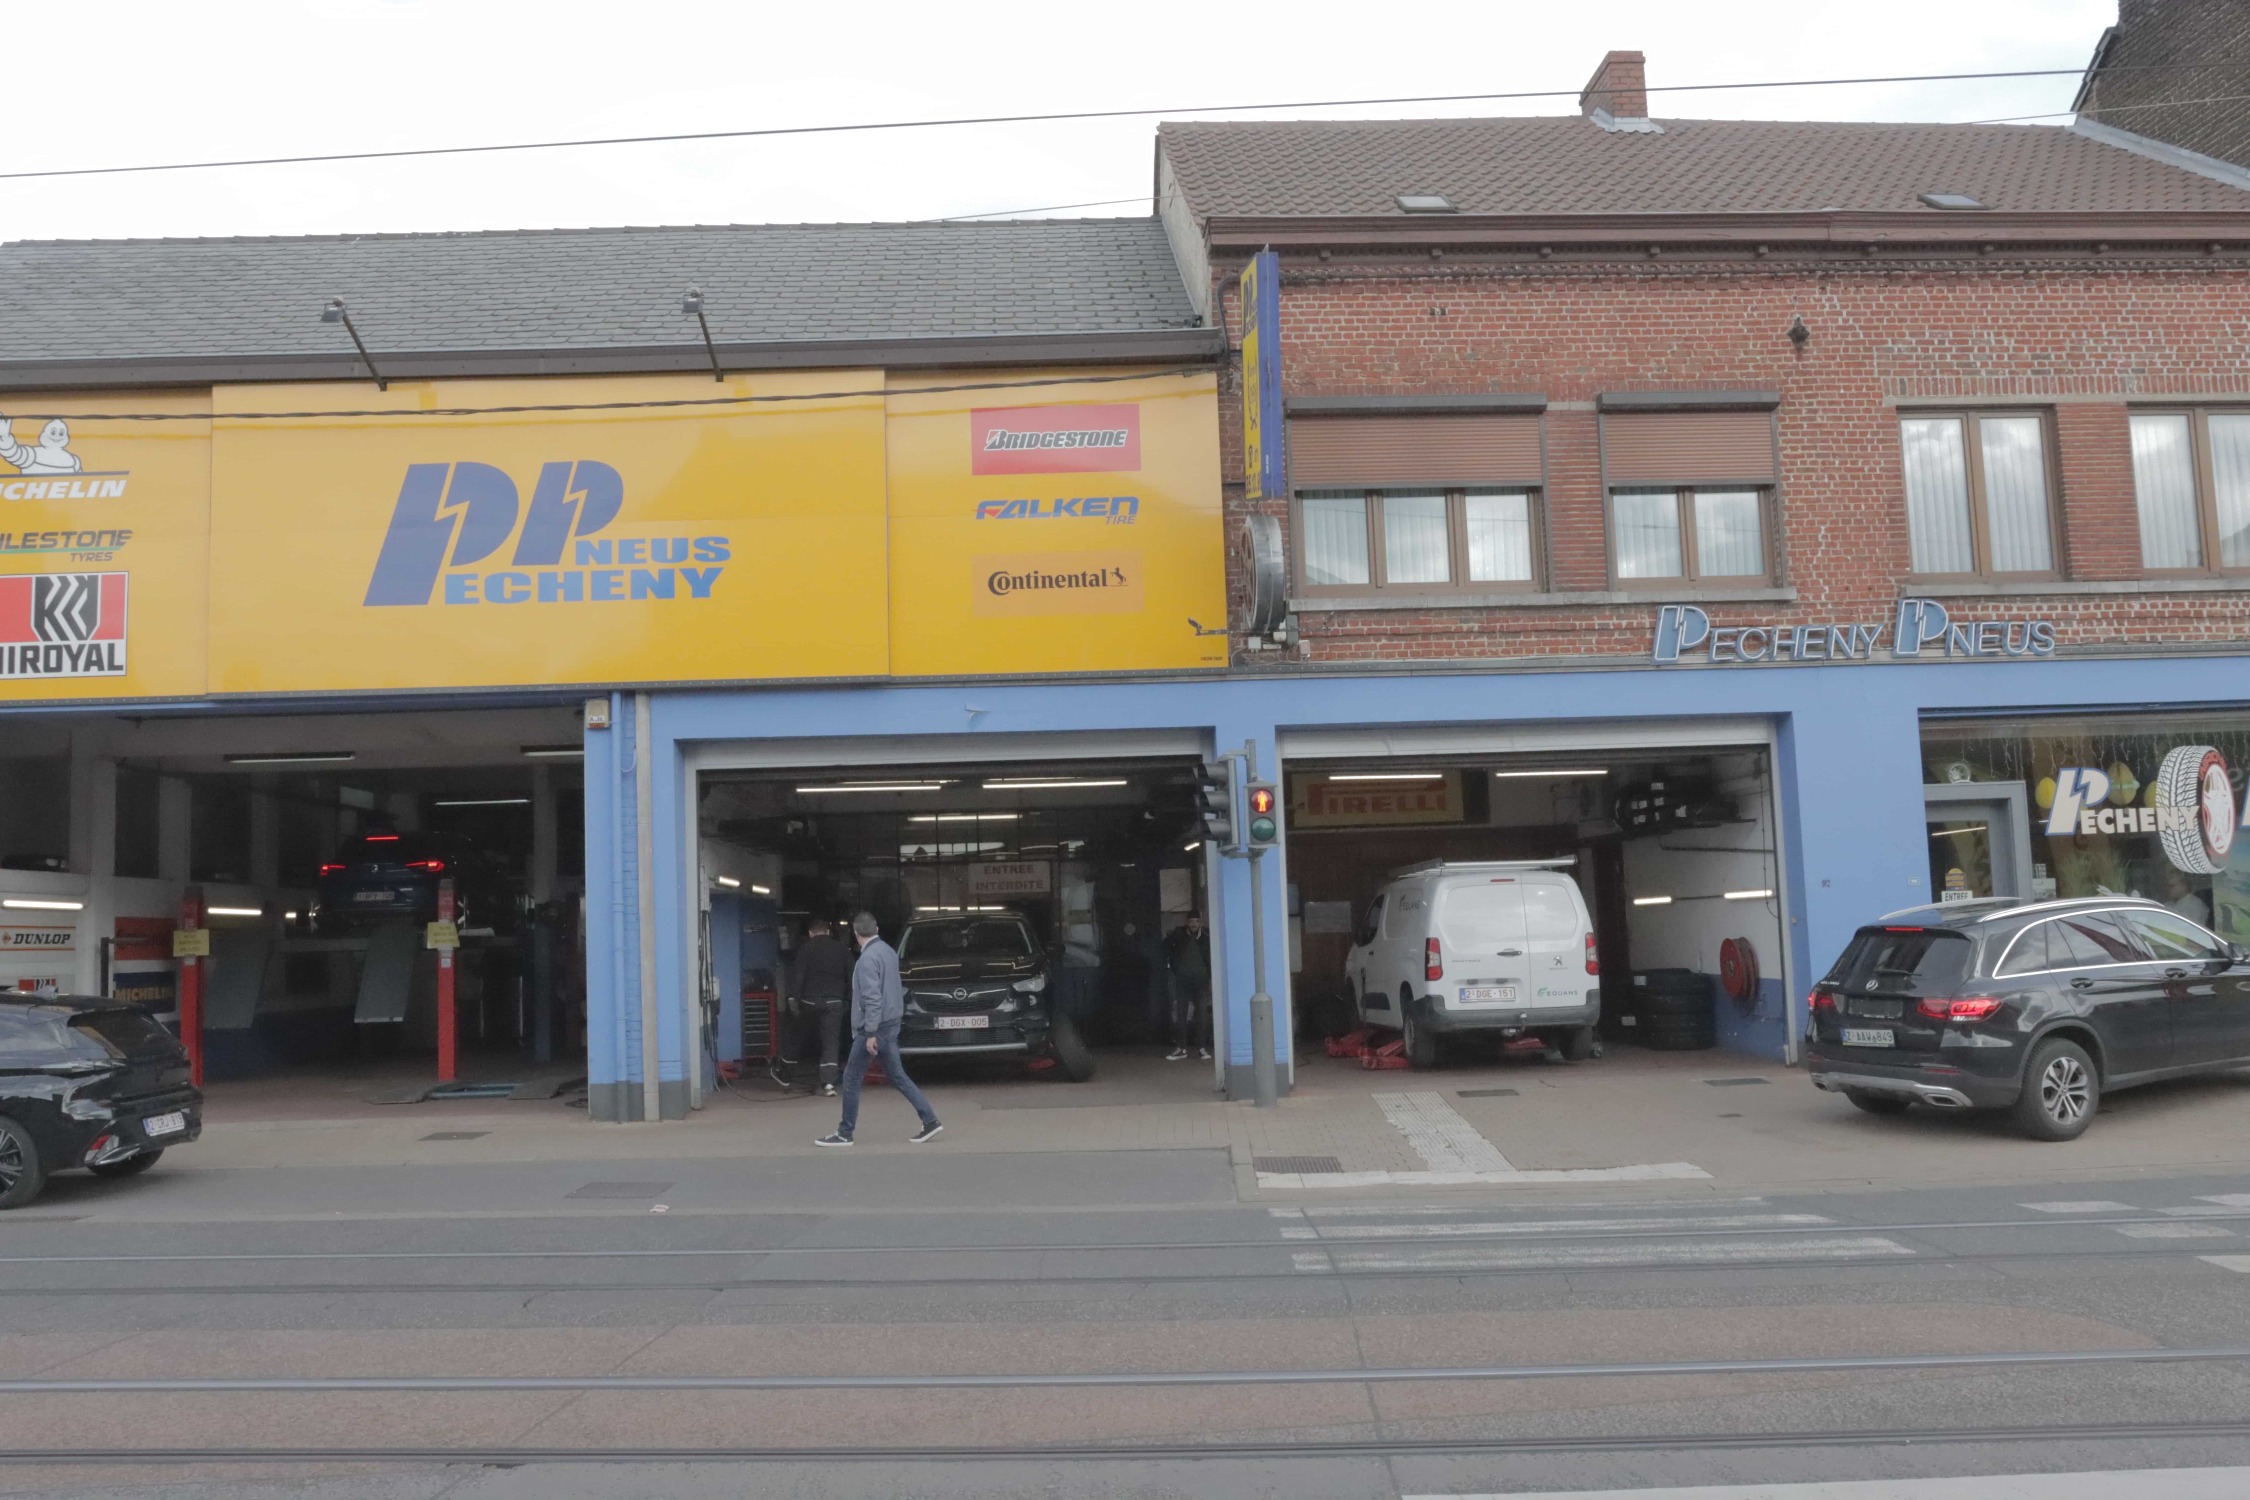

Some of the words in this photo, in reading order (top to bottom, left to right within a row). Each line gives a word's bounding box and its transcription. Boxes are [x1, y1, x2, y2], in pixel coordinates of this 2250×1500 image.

[984, 429, 1128, 451] BRIDGESTONE
[974, 496, 1139, 520] FALKEN
[1106, 515, 1136, 525] TIRE
[70, 551, 113, 562] TYRES
[988, 568, 1107, 596] Continental
[1650, 604, 1884, 666] PECHENY
[1892, 598, 2057, 660] PNEUS
[1307, 779, 1448, 816] PIRELLI
[2044, 767, 2199, 836] PECHENY
[984, 864, 1035, 875] ENTREE
[975, 880, 1044, 892] INTERDITE
[13, 933, 71, 945] DUNLOP
